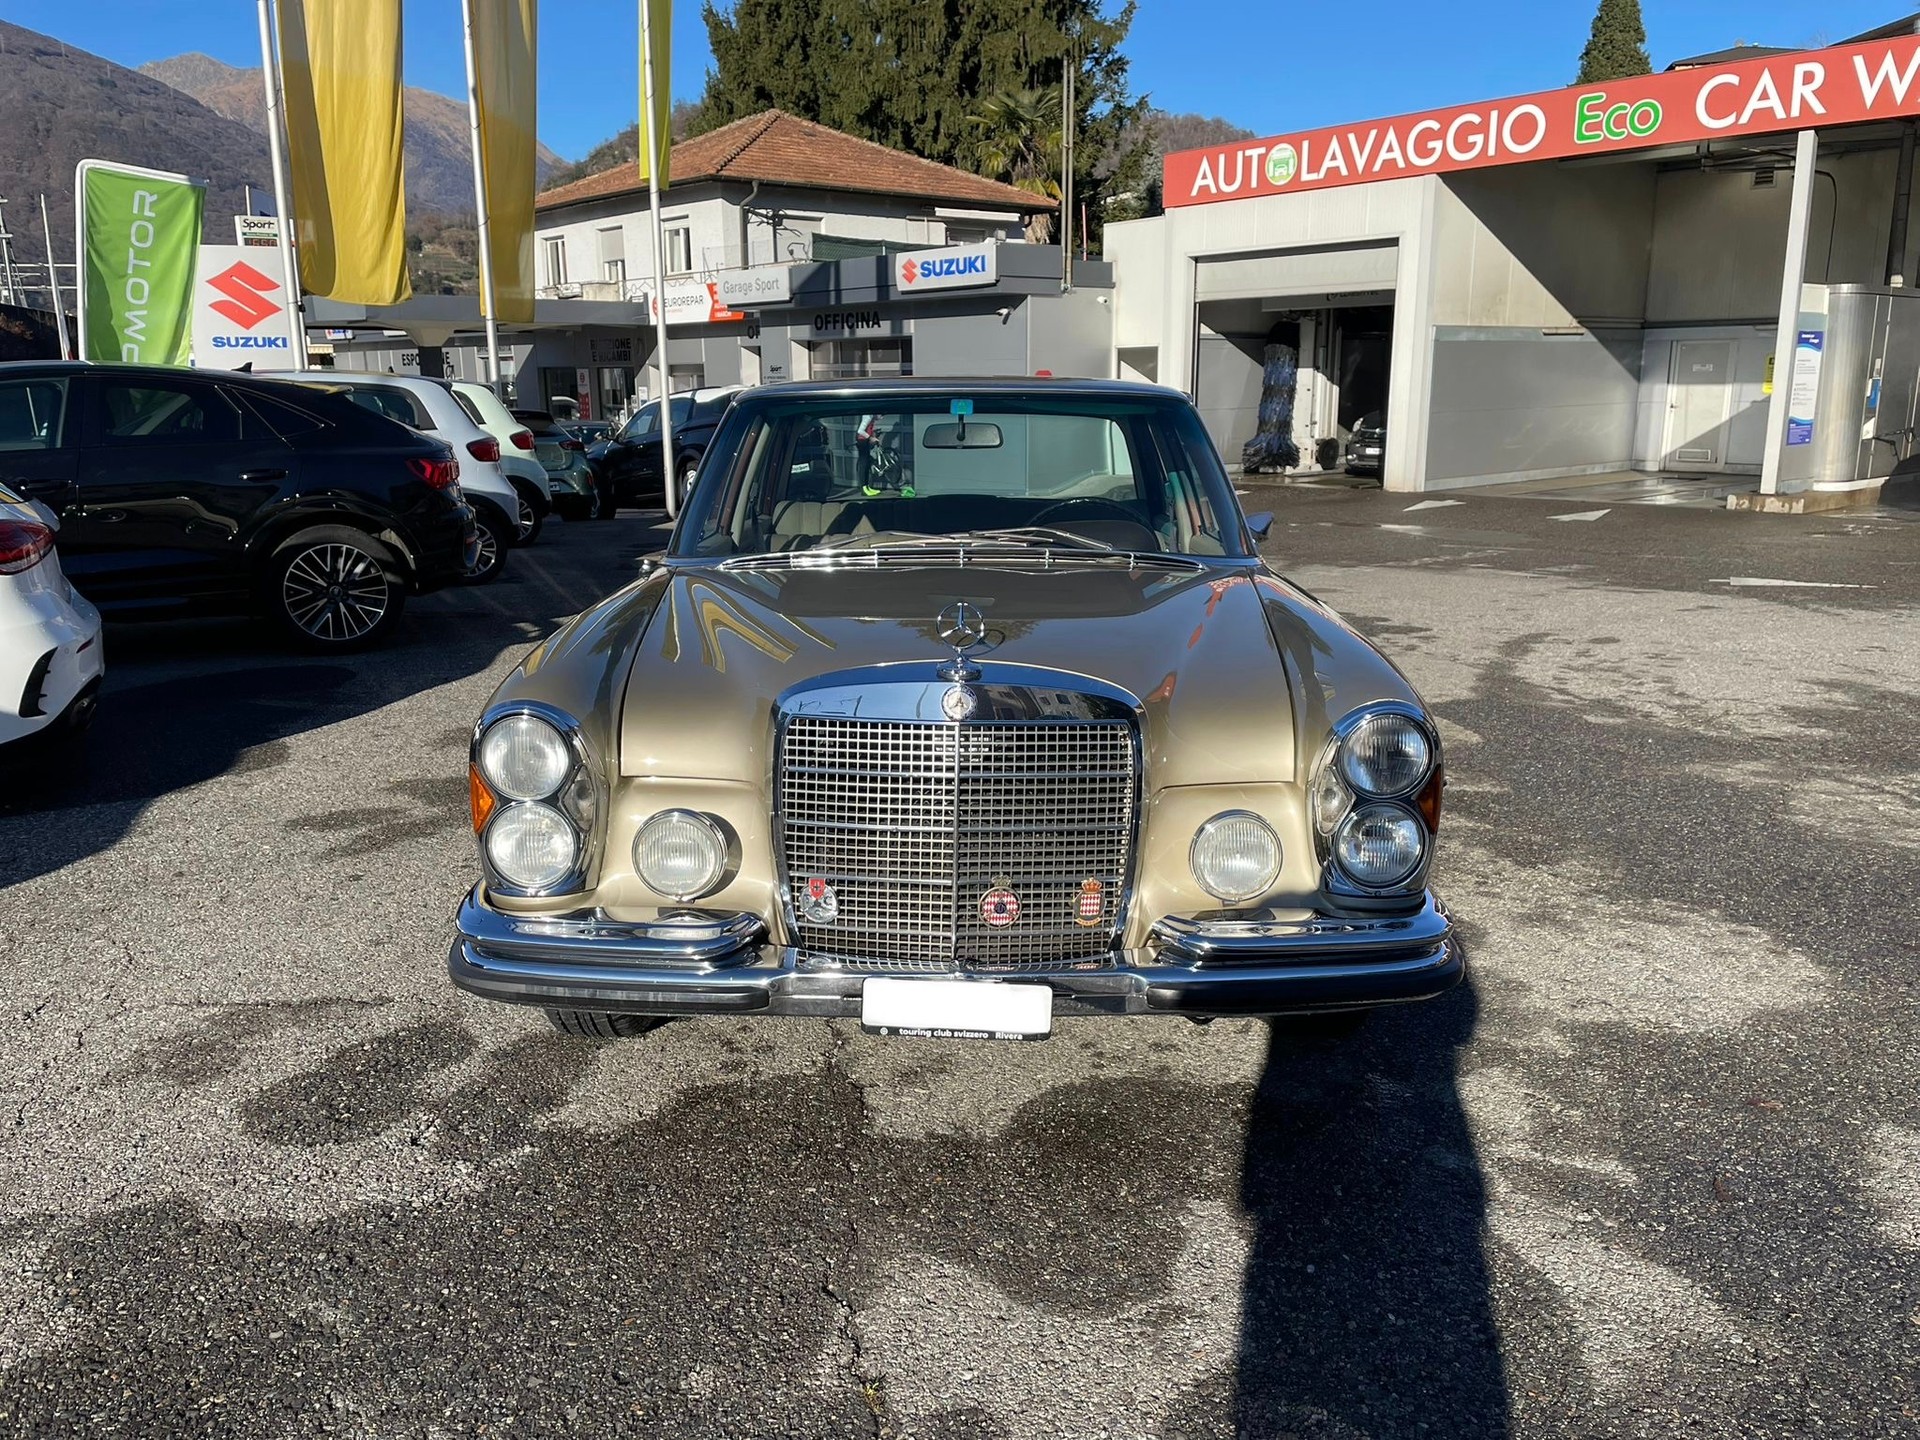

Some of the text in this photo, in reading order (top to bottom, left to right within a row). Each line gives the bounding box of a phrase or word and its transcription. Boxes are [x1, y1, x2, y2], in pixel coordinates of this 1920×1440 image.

[1695, 61, 1827, 129] CAR
[1852, 46, 1920, 110] W
[243, 219, 274, 231] Sport
[920, 255, 986, 278] SUZUKI
[723, 277, 780, 296] Garage Sport
[664, 295, 704, 308] EUROREPAR
[814, 311, 882, 331] OFFICINA
[212, 336, 288, 348] SUZUKI
[899, 1028, 1023, 1040] touring club svizzero Rivera
